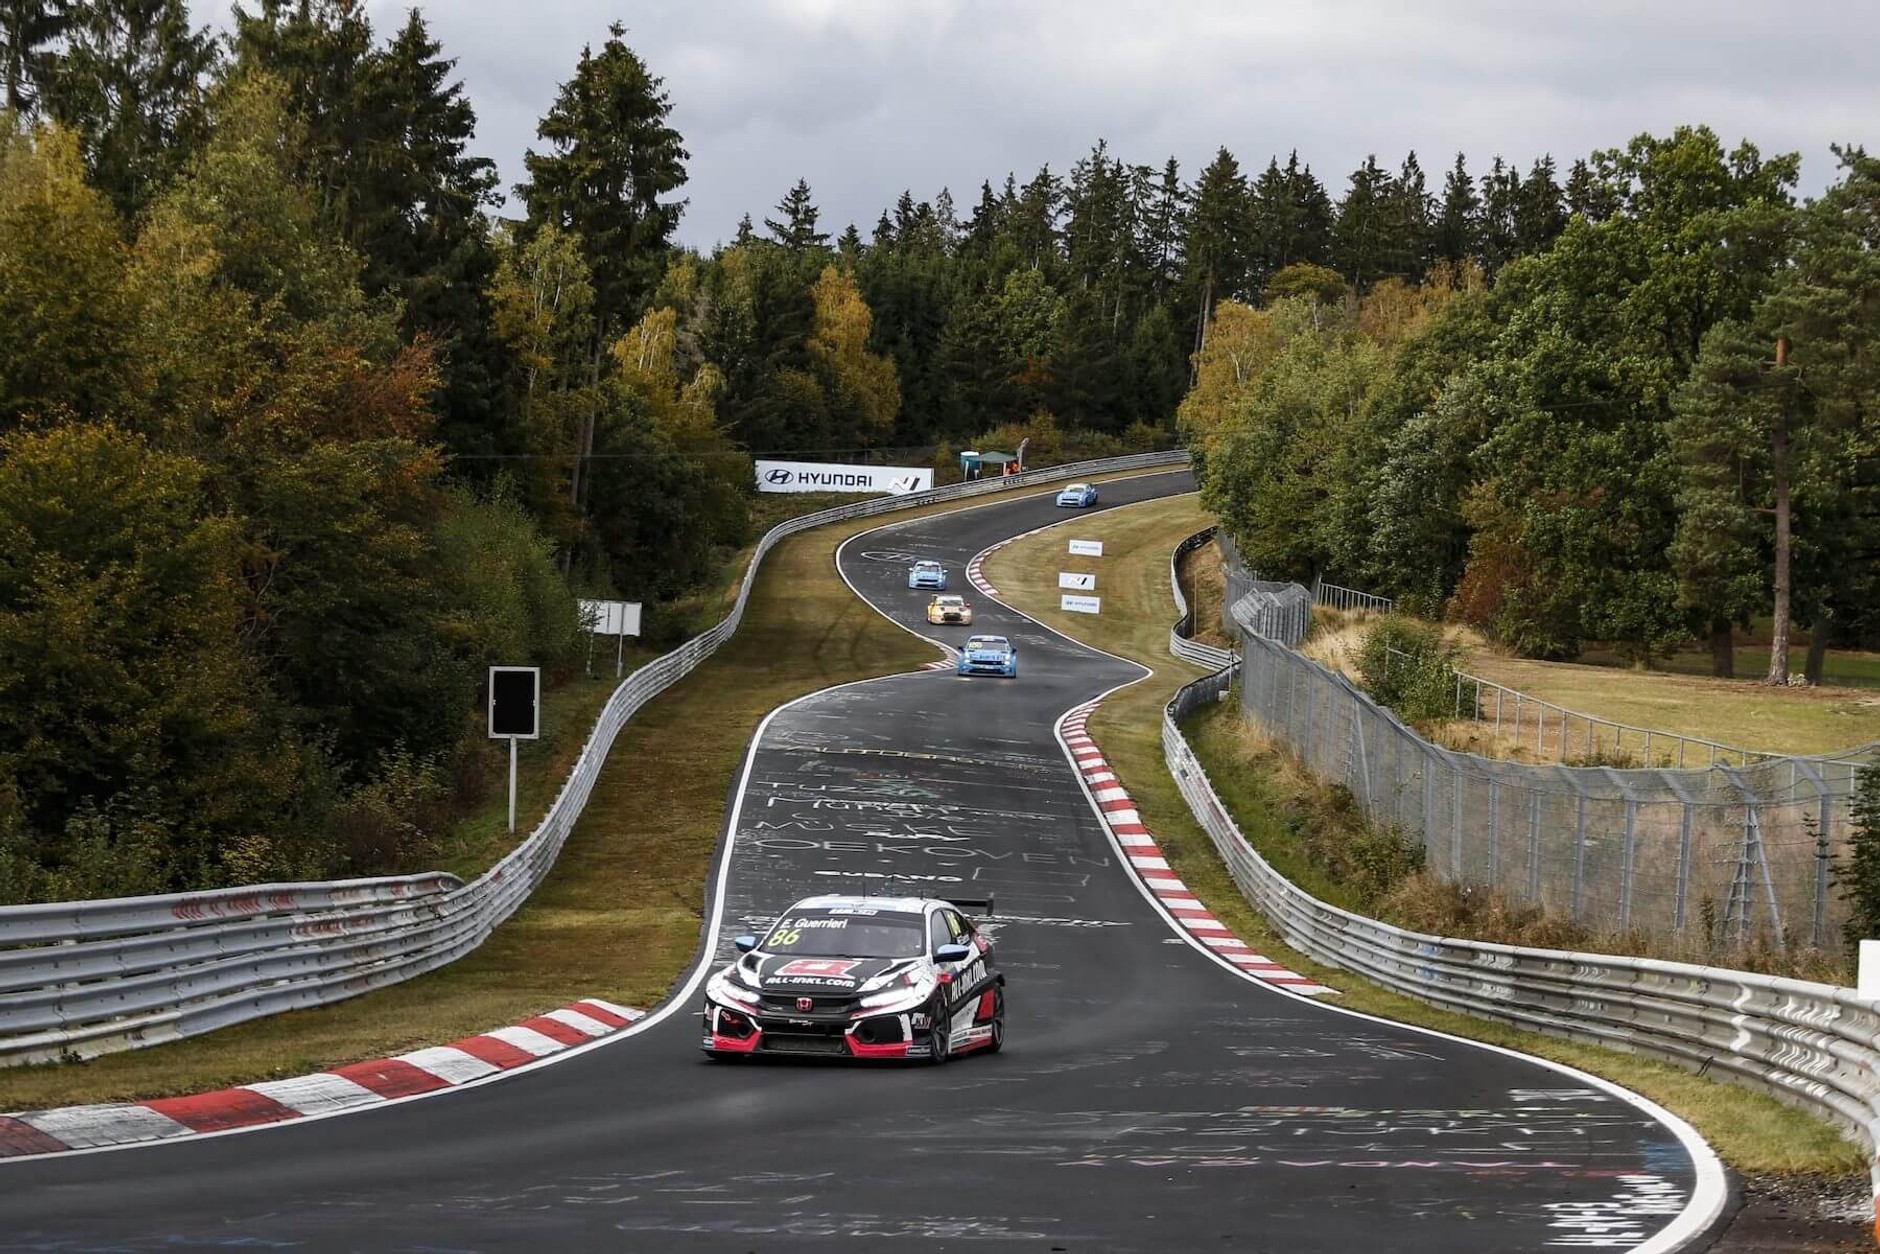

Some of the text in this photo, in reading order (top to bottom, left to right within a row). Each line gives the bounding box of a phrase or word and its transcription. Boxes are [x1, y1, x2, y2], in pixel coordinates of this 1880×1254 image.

[798, 471, 873, 487] HYUNDAI
[794, 918, 848, 930] Guerrieri
[767, 928, 802, 947] 86
